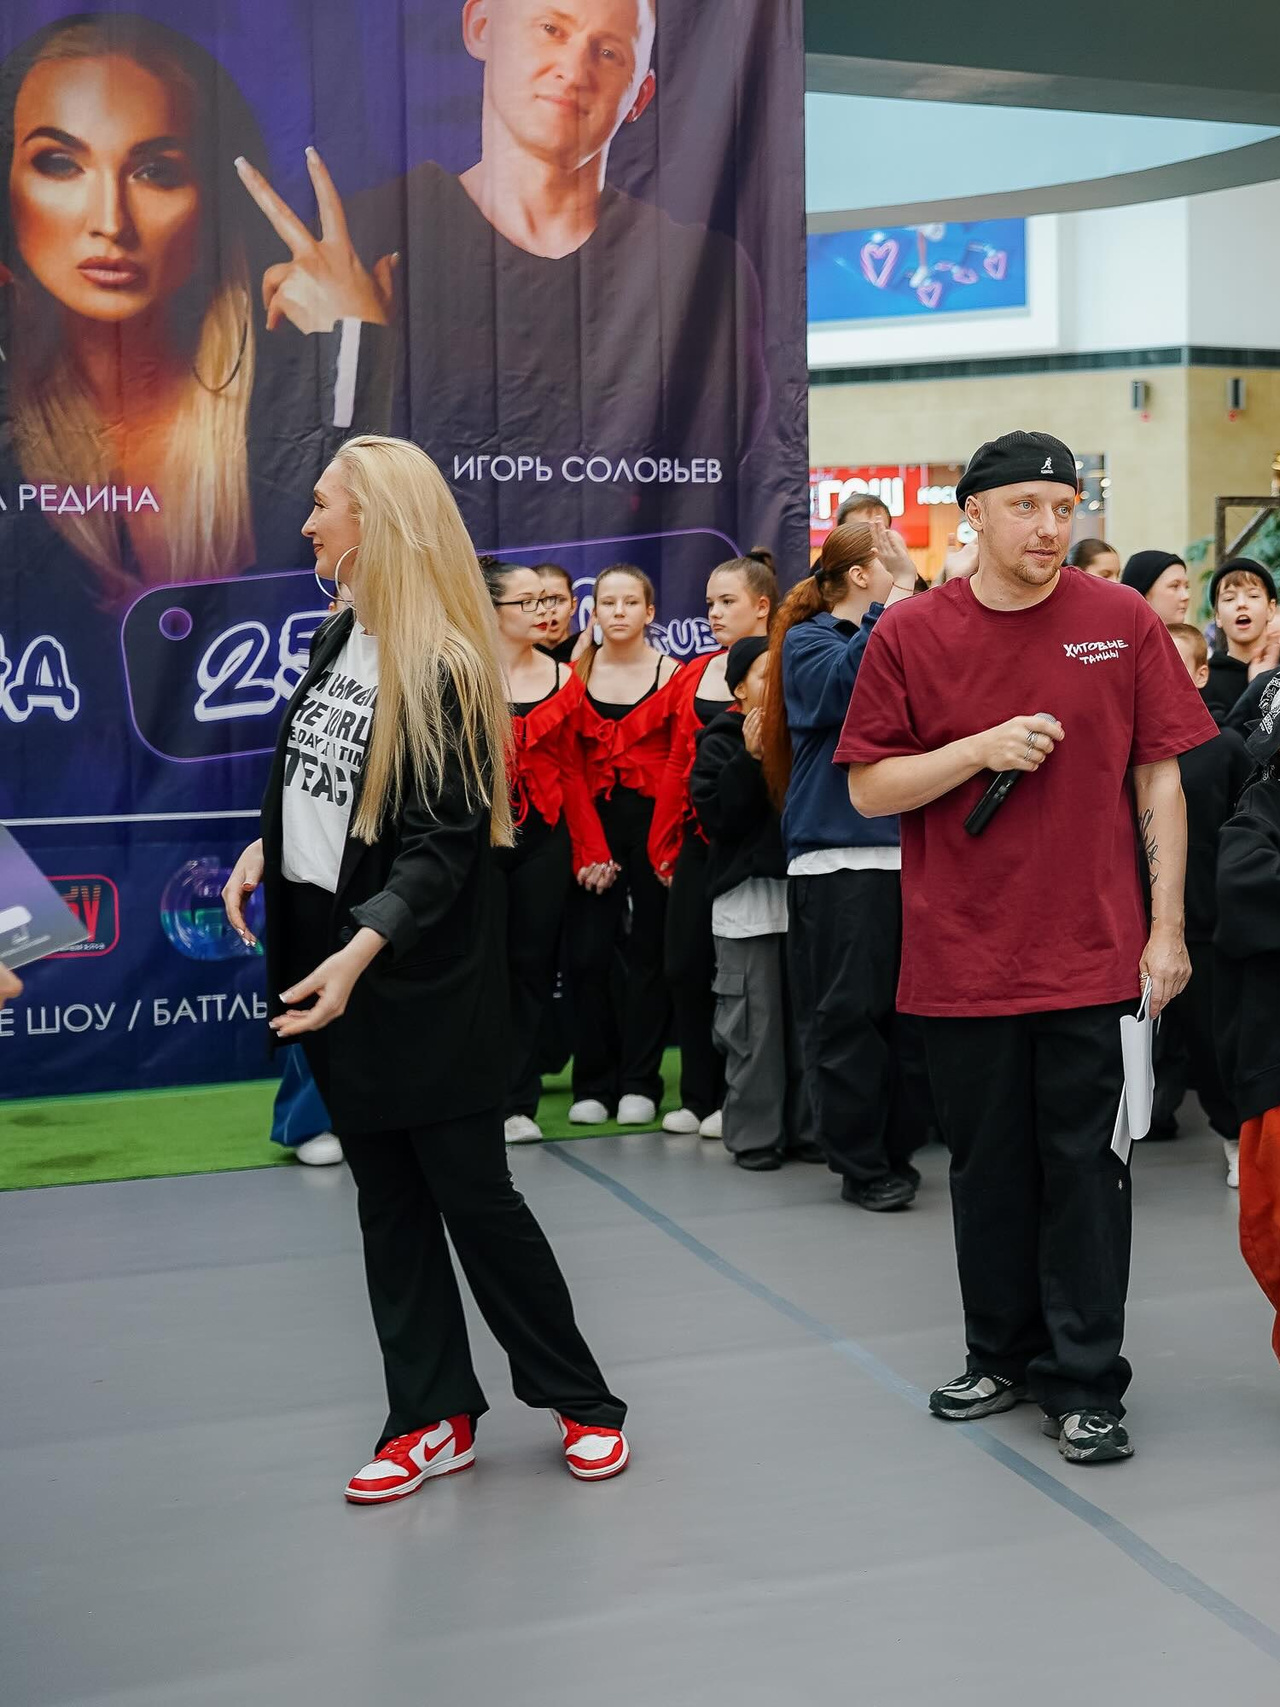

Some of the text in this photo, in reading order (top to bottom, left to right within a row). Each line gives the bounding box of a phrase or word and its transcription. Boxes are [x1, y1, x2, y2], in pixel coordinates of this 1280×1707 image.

[453, 455, 723, 484] ИГОРЬ СОЛОВЬЕВ
[18, 484, 160, 516] РЕДИНА
[1063, 640, 1128, 658] ХИТОВЫЕ
[1079, 650, 1119, 665] ТАНЦЫ
[27, 1002, 116, 1035] ШОУ
